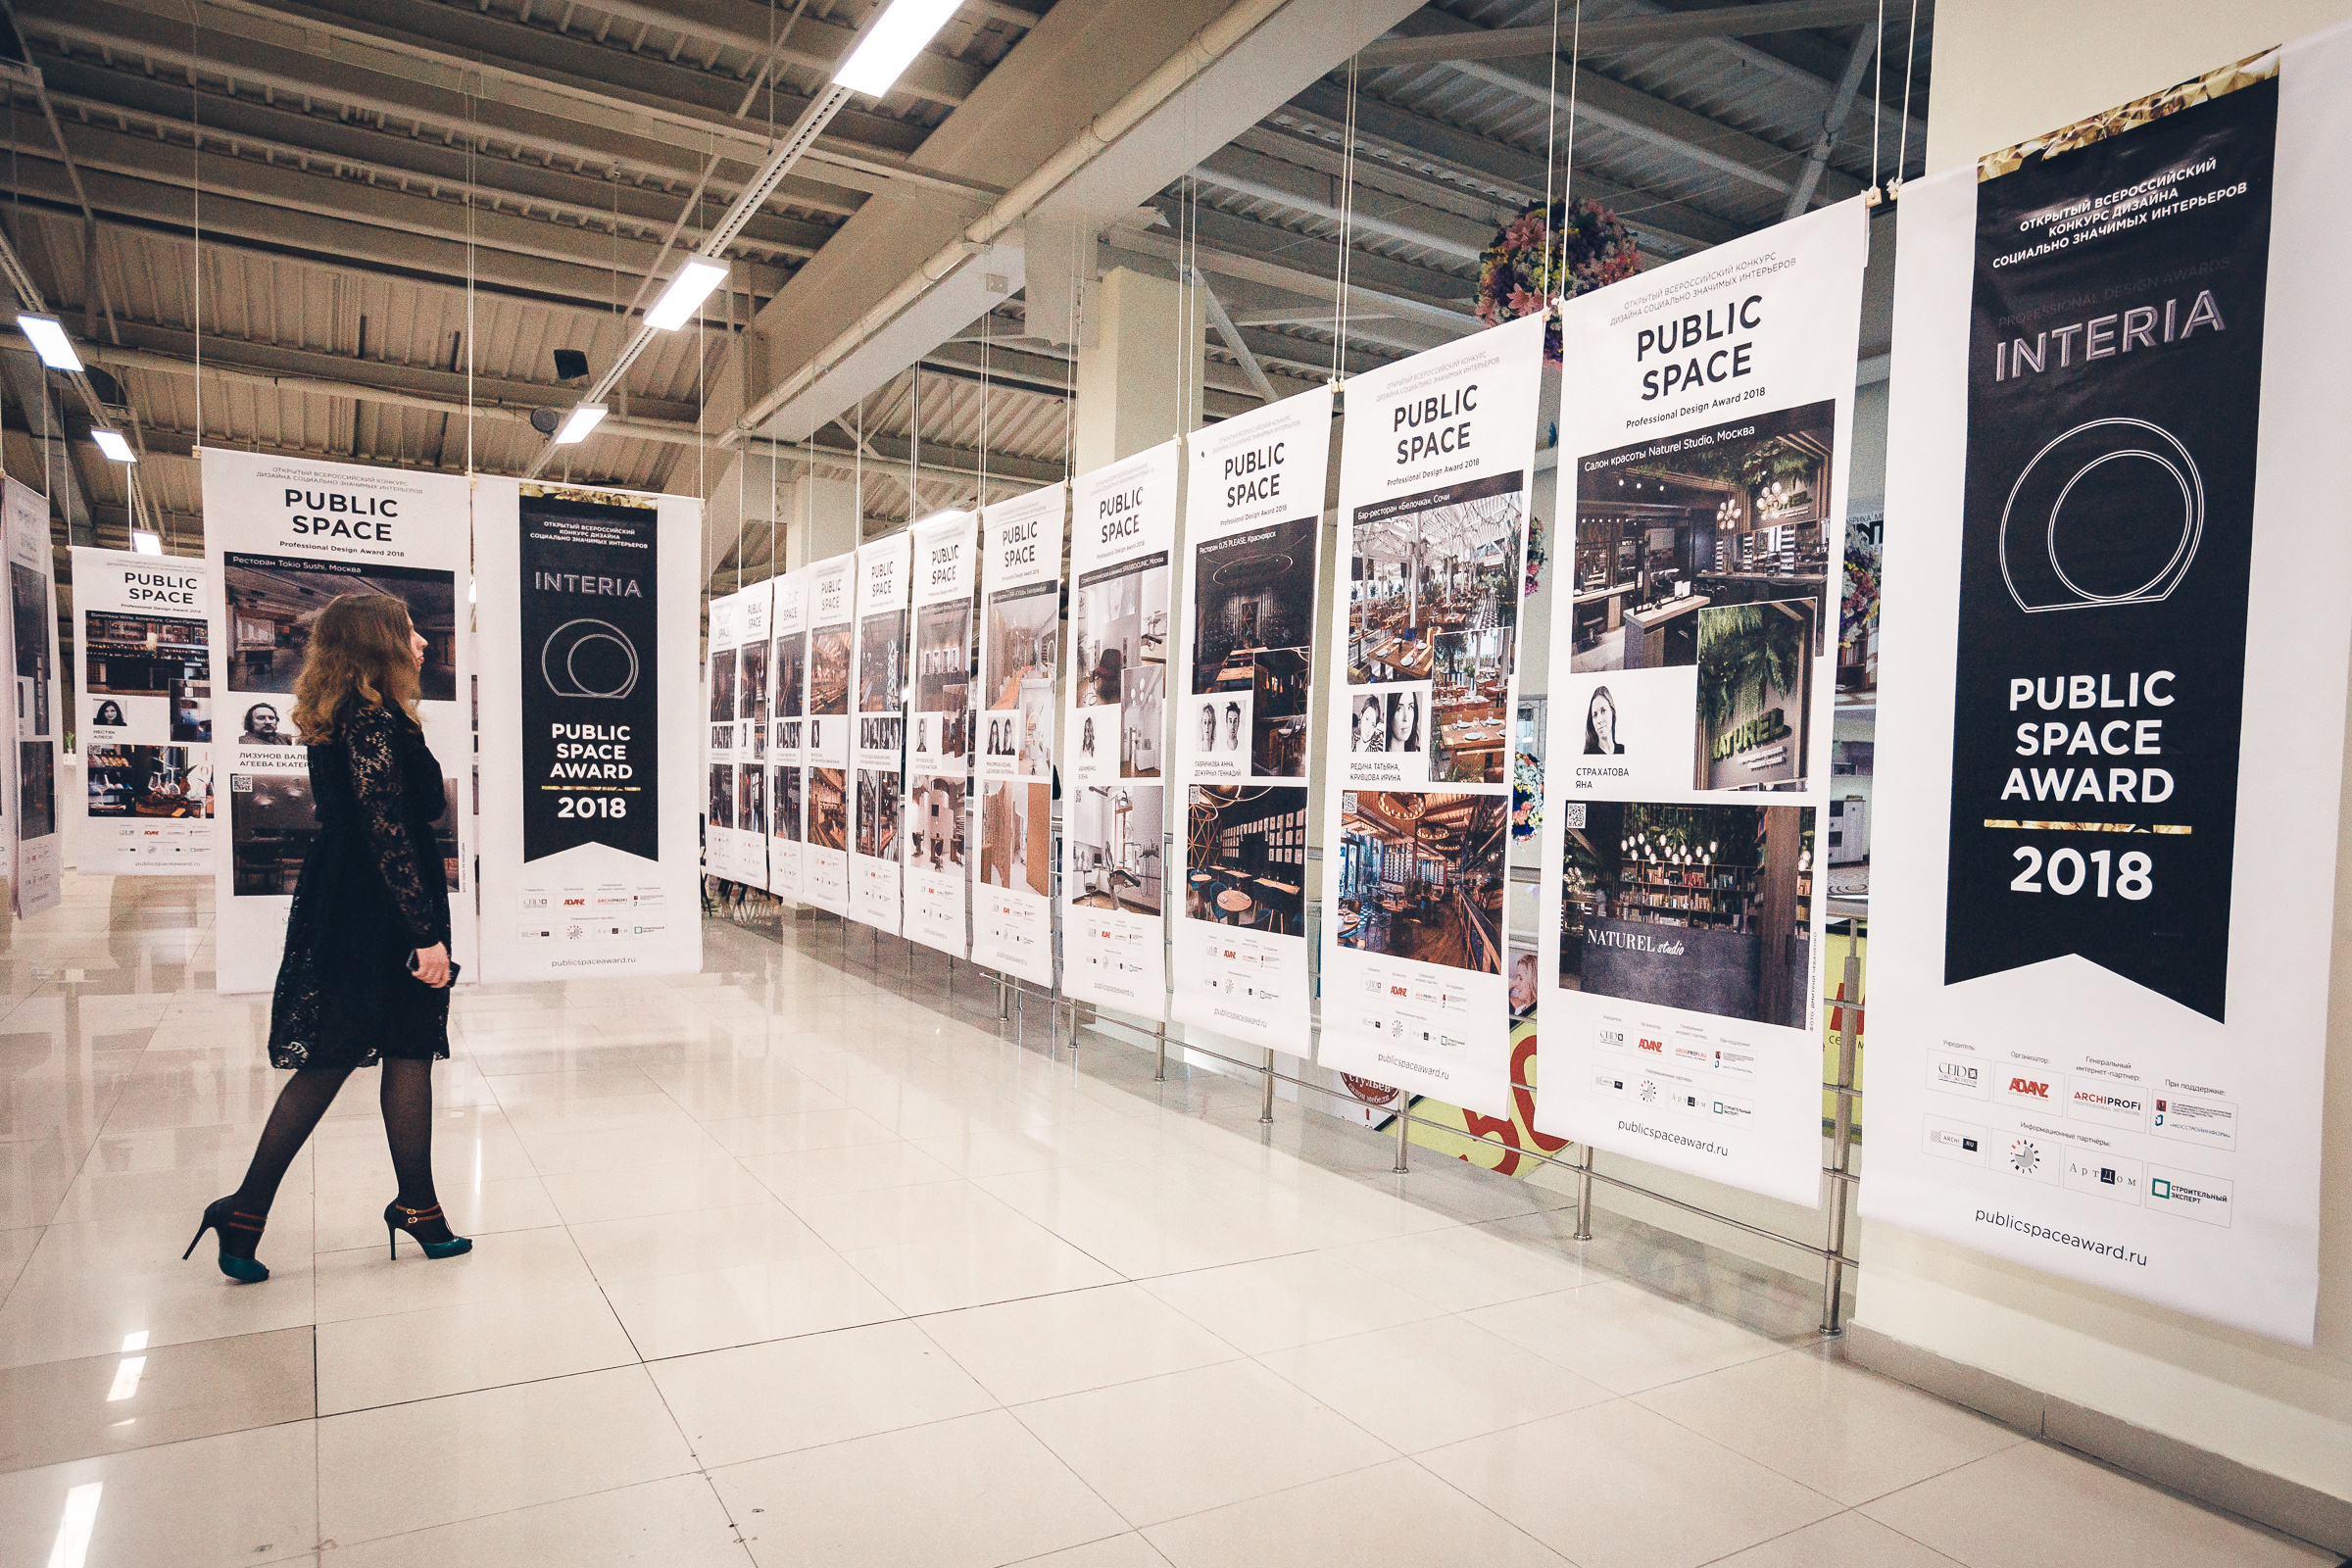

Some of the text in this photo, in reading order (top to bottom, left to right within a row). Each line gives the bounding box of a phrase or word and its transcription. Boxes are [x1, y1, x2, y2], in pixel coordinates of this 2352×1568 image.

[2020, 157, 2217, 232] ОТКРЫТЫЙ ВСЕРОССИЙСКИЙ
[2048, 187, 2179, 237] КОНКУРС ДИЗАЙНА
[1992, 181, 2247, 269] СОЦИАЛЬНО ЗНАЧИМЫХ ИНТЕРЬЕРОВ
[1609, 257, 1796, 326] ДИЗАЙНА СОЦИАЛЬНО ЗНАЧИМЫХ ИНТЕРЬЕРОВ
[1624, 252, 1777, 311] ОТКРЫТЫЙ ВСЕРОССИЙСКИЙ КОНКУРС
[1998, 257, 2230, 328] PROFESSIONAL DESIGN AWARDS
[1638, 294, 1763, 363] PUBLIC
[1995, 289, 2226, 382] INTERIA
[1387, 351, 1487, 390] ОТКРЫТЫЙ ВСЕРОССИЙСКИЙ КОНКУРС
[1463, 357, 1500, 375] ИНТЕРЬЕРОВ
[1641, 341, 1753, 401] SPACE
[1394, 384, 1478, 433] PUBLIC
[1626, 386, 1766, 429] Professional Design Award 2018
[1396, 421, 1471, 465] SPACE
[1584, 425, 1755, 472] Салон красоты Naturel Studio, Москва
[1224, 442, 1285, 480] PUBLIC
[1387, 458, 1480, 487] Professional Design Award 2018
[257, 471, 292, 480] ДИЗАЙНА
[293, 475, 339, 485] СОЦИАЛЬНО
[379, 484, 423, 494] ИНТЕРЬЕРОВ
[271, 466, 409, 487] ОТКРЫТЫЙ ВСЕРОССИЙСКИЙ КОНКУРС
[1227, 473, 1280, 508] SPACE
[284, 489, 398, 518] PUBLIC
[1100, 486, 1144, 519] PUBLIC
[1357, 504, 1397, 520] Бар-ресторан
[1433, 494, 1450, 504] Сочи
[1220, 504, 1288, 526] Professional Design Award 2018
[292, 514, 392, 542] SPACE
[543, 521, 636, 535] ОТКРЫТЫЙ ВСЕРОССИЙСКИЙ
[1003, 521, 1038, 546] PUBLIC
[1102, 514, 1140, 544] SPACE
[279, 540, 328, 551] Professional
[331, 545, 358, 554] Design
[530, 532, 649, 549] СОЦИАЛЬНО ЗНАЧИМЫХ ИНТЕРЬЕРОВ
[233, 557, 362, 573] Ресторан Tokio Sushi, Москва
[932, 544, 959, 565] PUBLIC
[1004, 545, 1035, 567] SPACE
[124, 571, 197, 590] PUBLIC
[871, 561, 894, 579] PUBLIC
[932, 565, 956, 585] SPACE
[535, 571, 643, 598] INTERIA
[821, 578, 842, 595] PUBLIC
[872, 580, 892, 597] SPACE
[128, 588, 194, 605] SPACE
[748, 602, 762, 614] PUBLIC
[821, 596, 840, 611] SPACE
[749, 616, 761, 629] SPACE
[2009, 670, 2176, 711] PUBLIC
[552, 722, 631, 741] PUBLIC
[2015, 719, 2163, 757] SPACE
[556, 743, 626, 760] SPACE
[550, 762, 633, 779] AWARD
[1350, 762, 1373, 771] РЕДИНА
[1576, 767, 1630, 777] СТРАХАТОВА
[1575, 780, 1593, 789] ЯНА
[2000, 767, 2175, 804] AWARD
[558, 797, 626, 818] 2018
[2010, 846, 2153, 901] 2018
[1588, 928, 1685, 956] NATUREL studio
[551, 956, 636, 968] publicspaceaward.ru
[1214, 1007, 1267, 1028] publicspaceaward.ru
[1378, 1054, 1449, 1080] publicspaceaward.ru
[2010, 1052, 2050, 1064] Организатор:
[2085, 1055, 2132, 1069] Генеральный
[2076, 1065, 2141, 1081] интернет-партнер:
[2165, 1079, 2227, 1096] При поддержке:
[1618, 1119, 1729, 1156] publicspaceaward.ru
[2020, 1121, 2111, 1147] Информационные партнеры:
[2171, 1185, 2228, 1202] СТРОИТЕЛЬНЫЙ
[2171, 1193, 2201, 1204] ЭКСПЕРТ
[1975, 1208, 2148, 1267] publicspaceaward.ru
